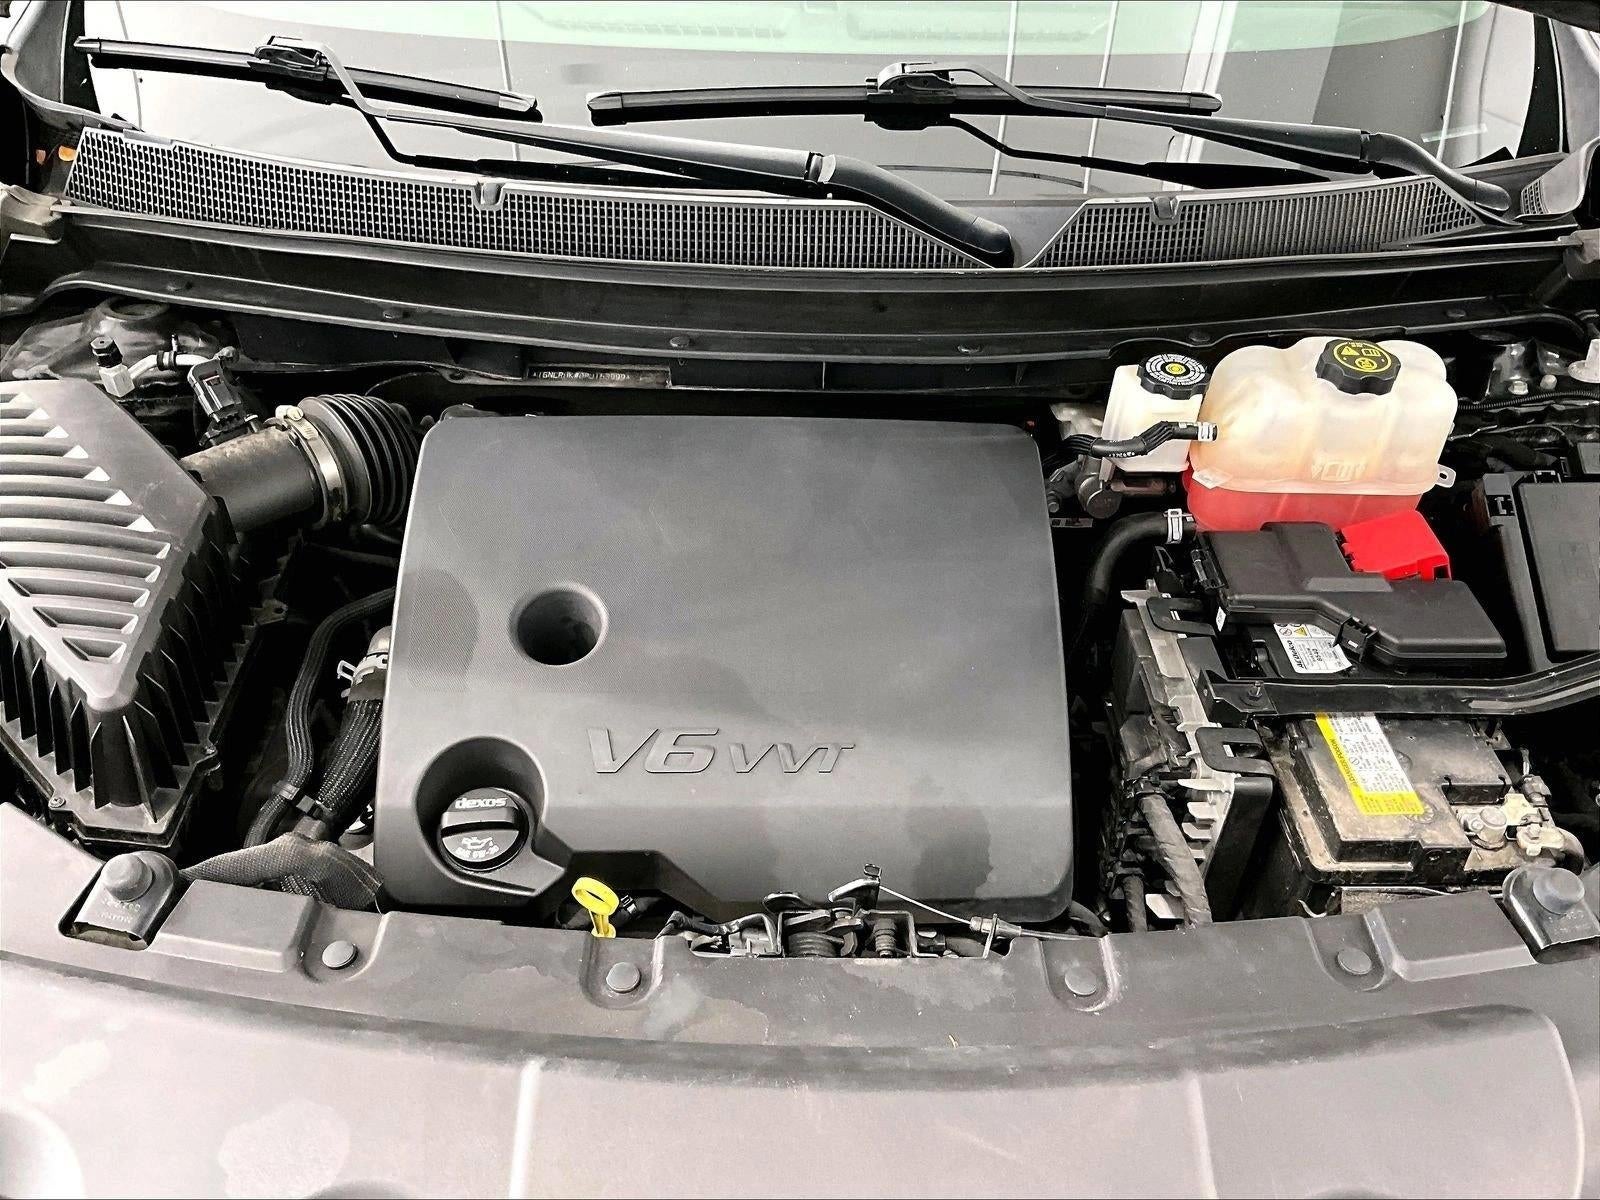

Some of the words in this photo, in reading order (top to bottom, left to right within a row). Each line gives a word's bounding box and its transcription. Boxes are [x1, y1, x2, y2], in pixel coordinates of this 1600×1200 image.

[586, 728, 719, 774] V6
[729, 743, 856, 774] VVT
[455, 798, 508, 809] dexos
